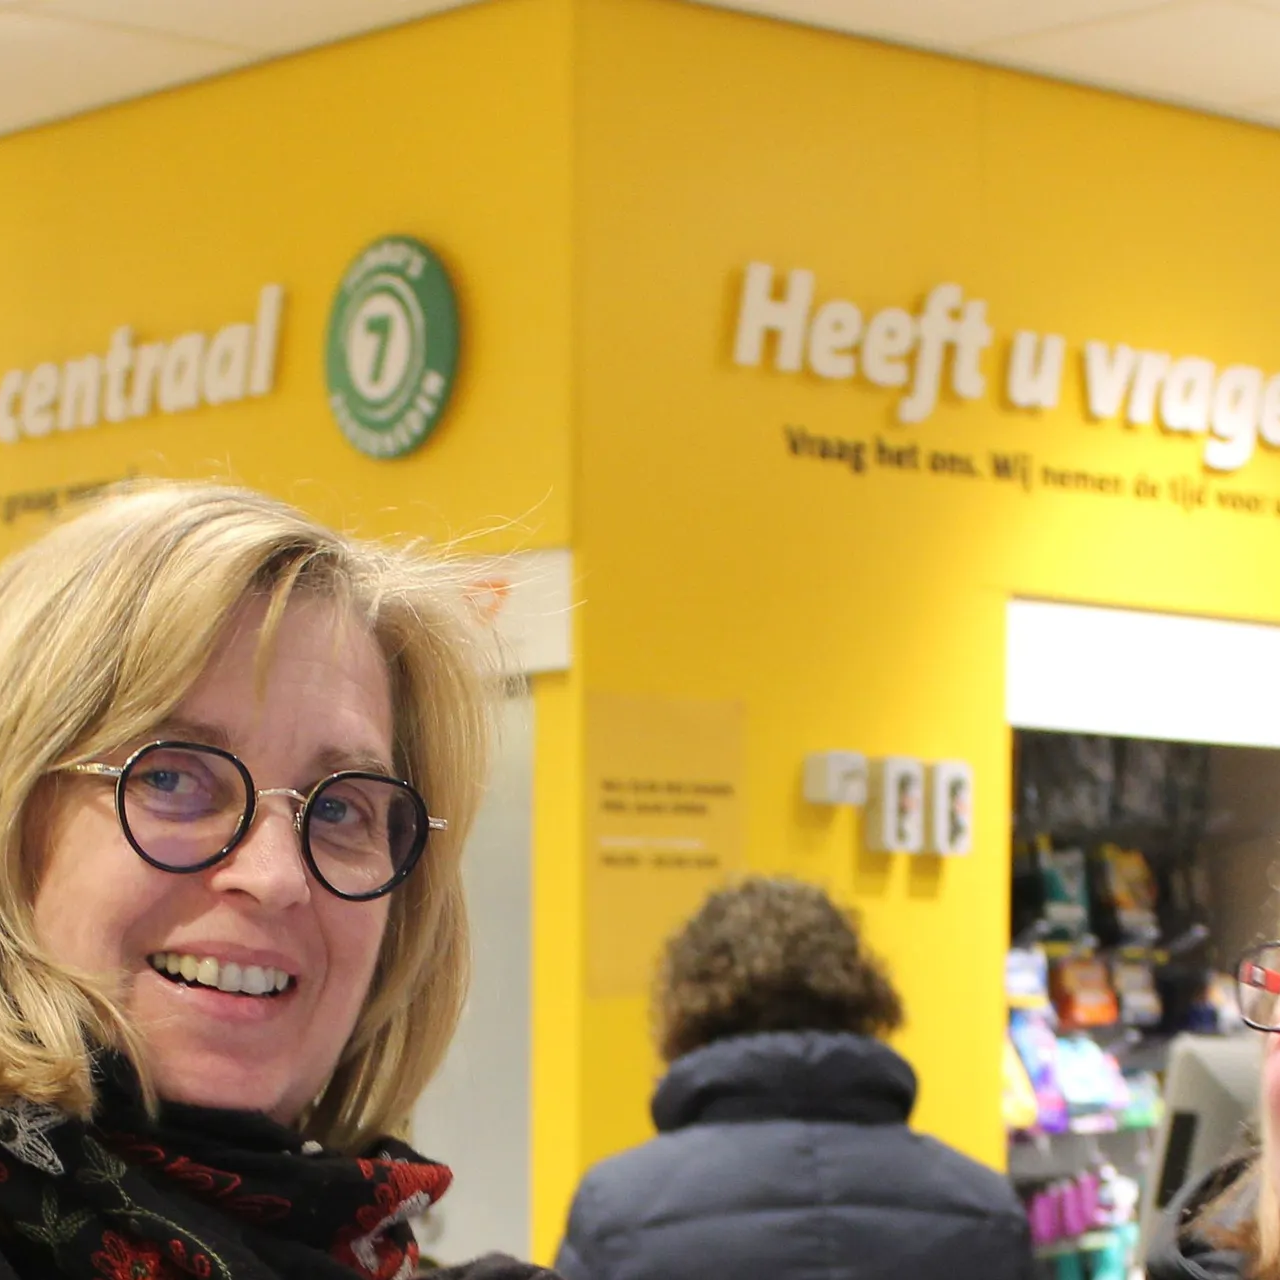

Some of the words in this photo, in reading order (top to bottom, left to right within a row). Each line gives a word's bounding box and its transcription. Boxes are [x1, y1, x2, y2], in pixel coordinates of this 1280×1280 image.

[365, 314, 394, 384] 7
[733, 261, 993, 424] Heeft
[1007, 330, 1065, 410] u
[783, 424, 866, 474] Vraag
[876, 433, 920, 470] het
[929, 450, 982, 478] ons.
[991, 449, 1032, 493] Wij
[1042, 465, 1123, 496] nemen
[1133, 472, 1160, 500] de
[1169, 474, 1208, 514] tijd
